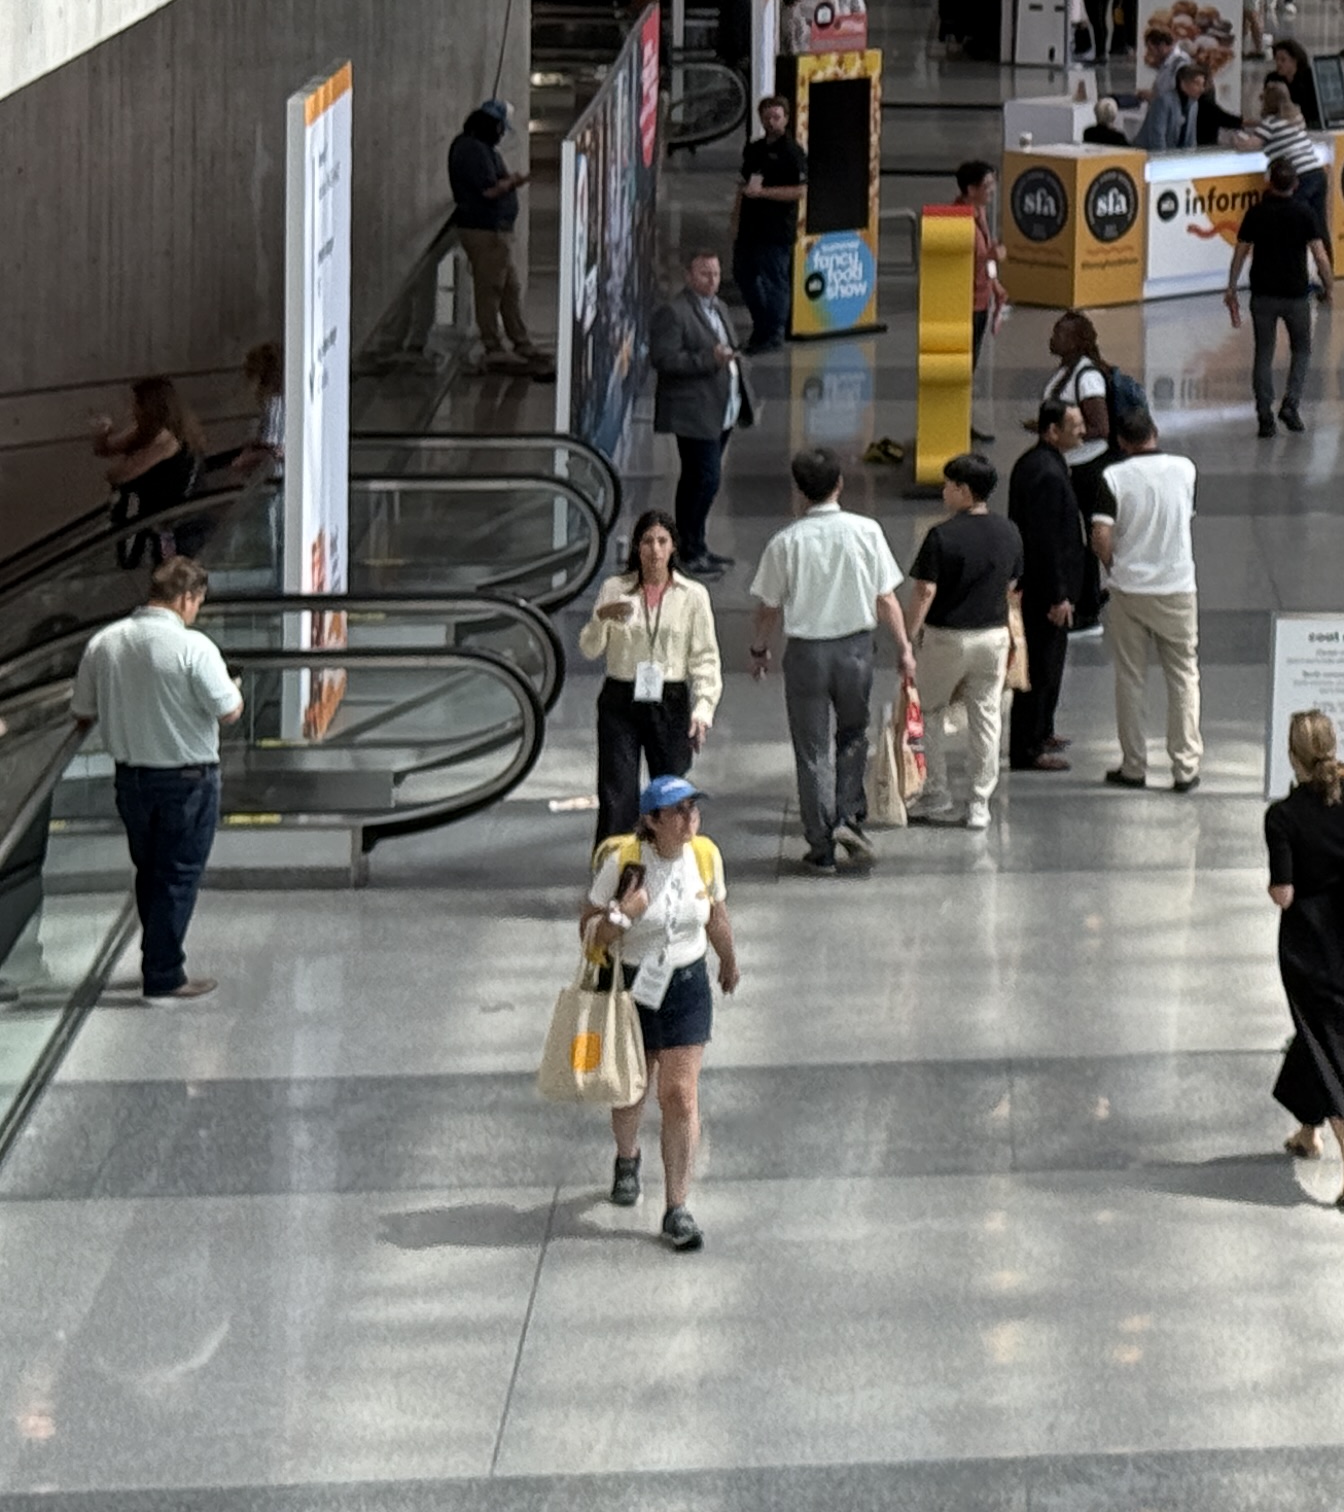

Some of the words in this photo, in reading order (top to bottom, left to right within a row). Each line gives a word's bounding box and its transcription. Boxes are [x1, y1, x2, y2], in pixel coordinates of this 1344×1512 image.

[1096, 187, 1128, 217] sfa
[1185, 187, 1260, 216] inform
[813, 249, 860, 272] fancy
[827, 260, 863, 284] food
[826, 278, 868, 301] show
